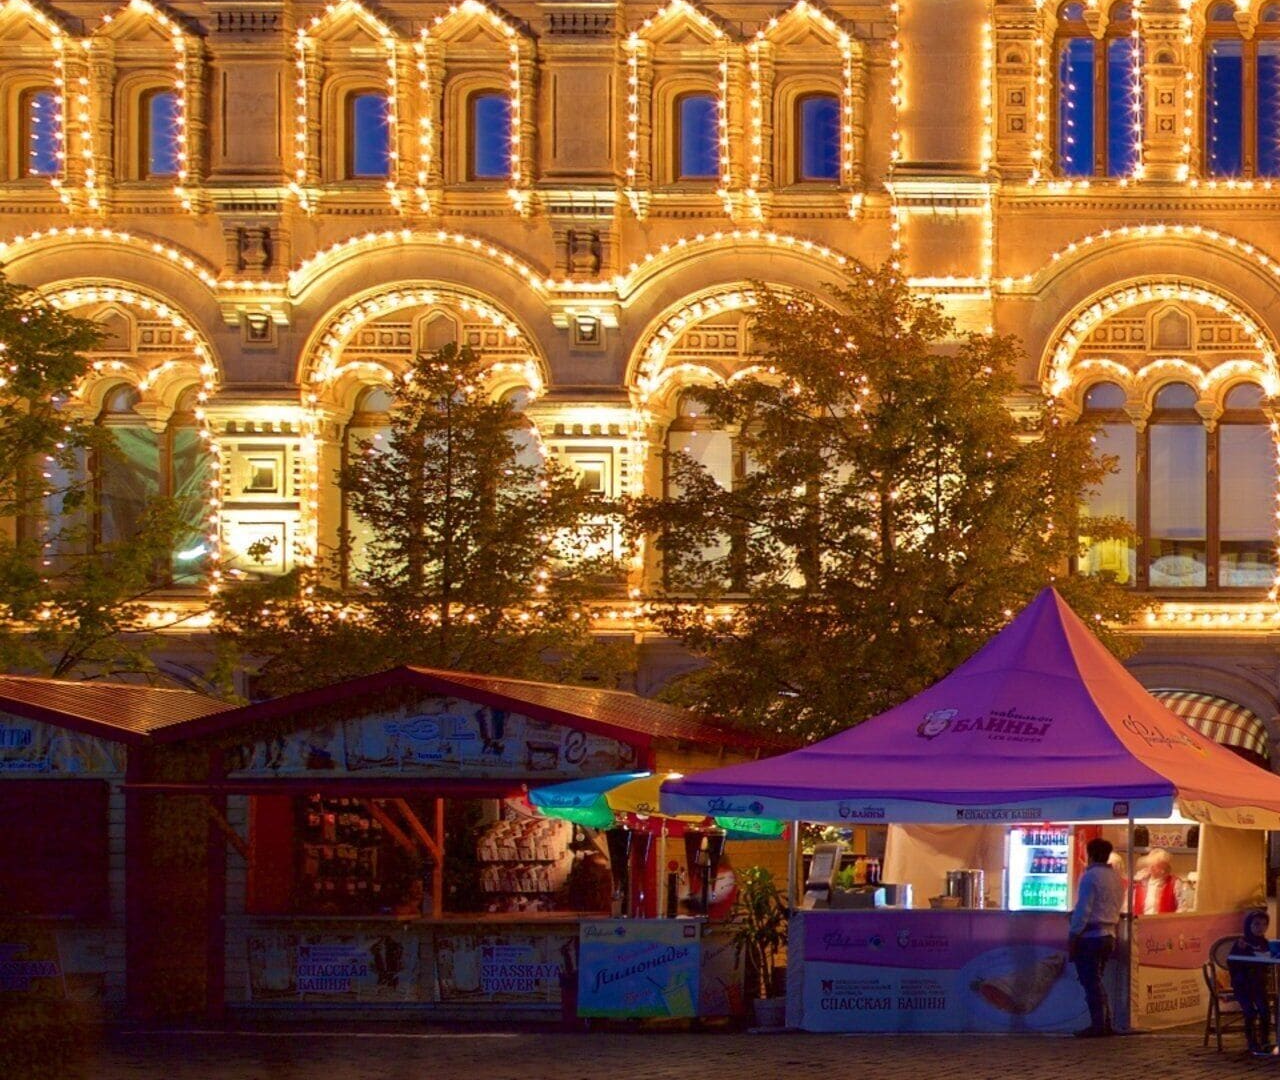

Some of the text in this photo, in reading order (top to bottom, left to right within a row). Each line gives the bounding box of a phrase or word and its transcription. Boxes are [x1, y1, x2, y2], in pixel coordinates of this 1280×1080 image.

[952, 717, 1052, 736] БЛИНЫ
[298, 964, 367, 977] СПАССКАЯ
[482, 964, 561, 978] SPASSKAYA
[299, 978, 347, 991] БАШНЯ
[482, 978, 535, 991] TOWER
[820, 997, 946, 1010] СПАССКАЯ БАШНЯ
